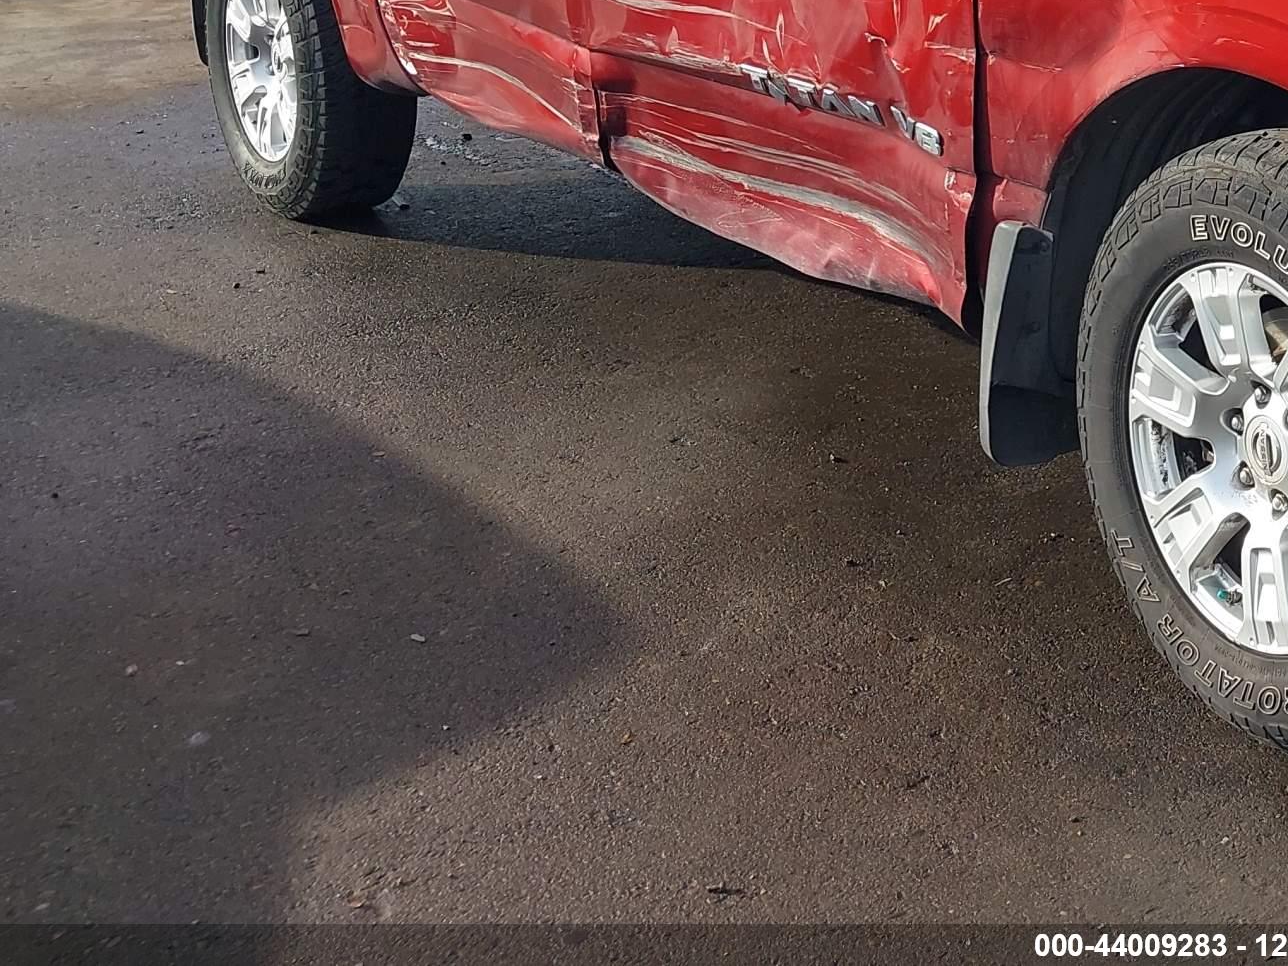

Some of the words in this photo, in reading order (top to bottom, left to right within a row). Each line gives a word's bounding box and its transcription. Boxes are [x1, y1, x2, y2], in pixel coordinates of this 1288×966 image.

[890, 105, 944, 158] V8
[1259, 428, 1270, 472] NISSAN
[1110, 528, 1161, 603] A/T
